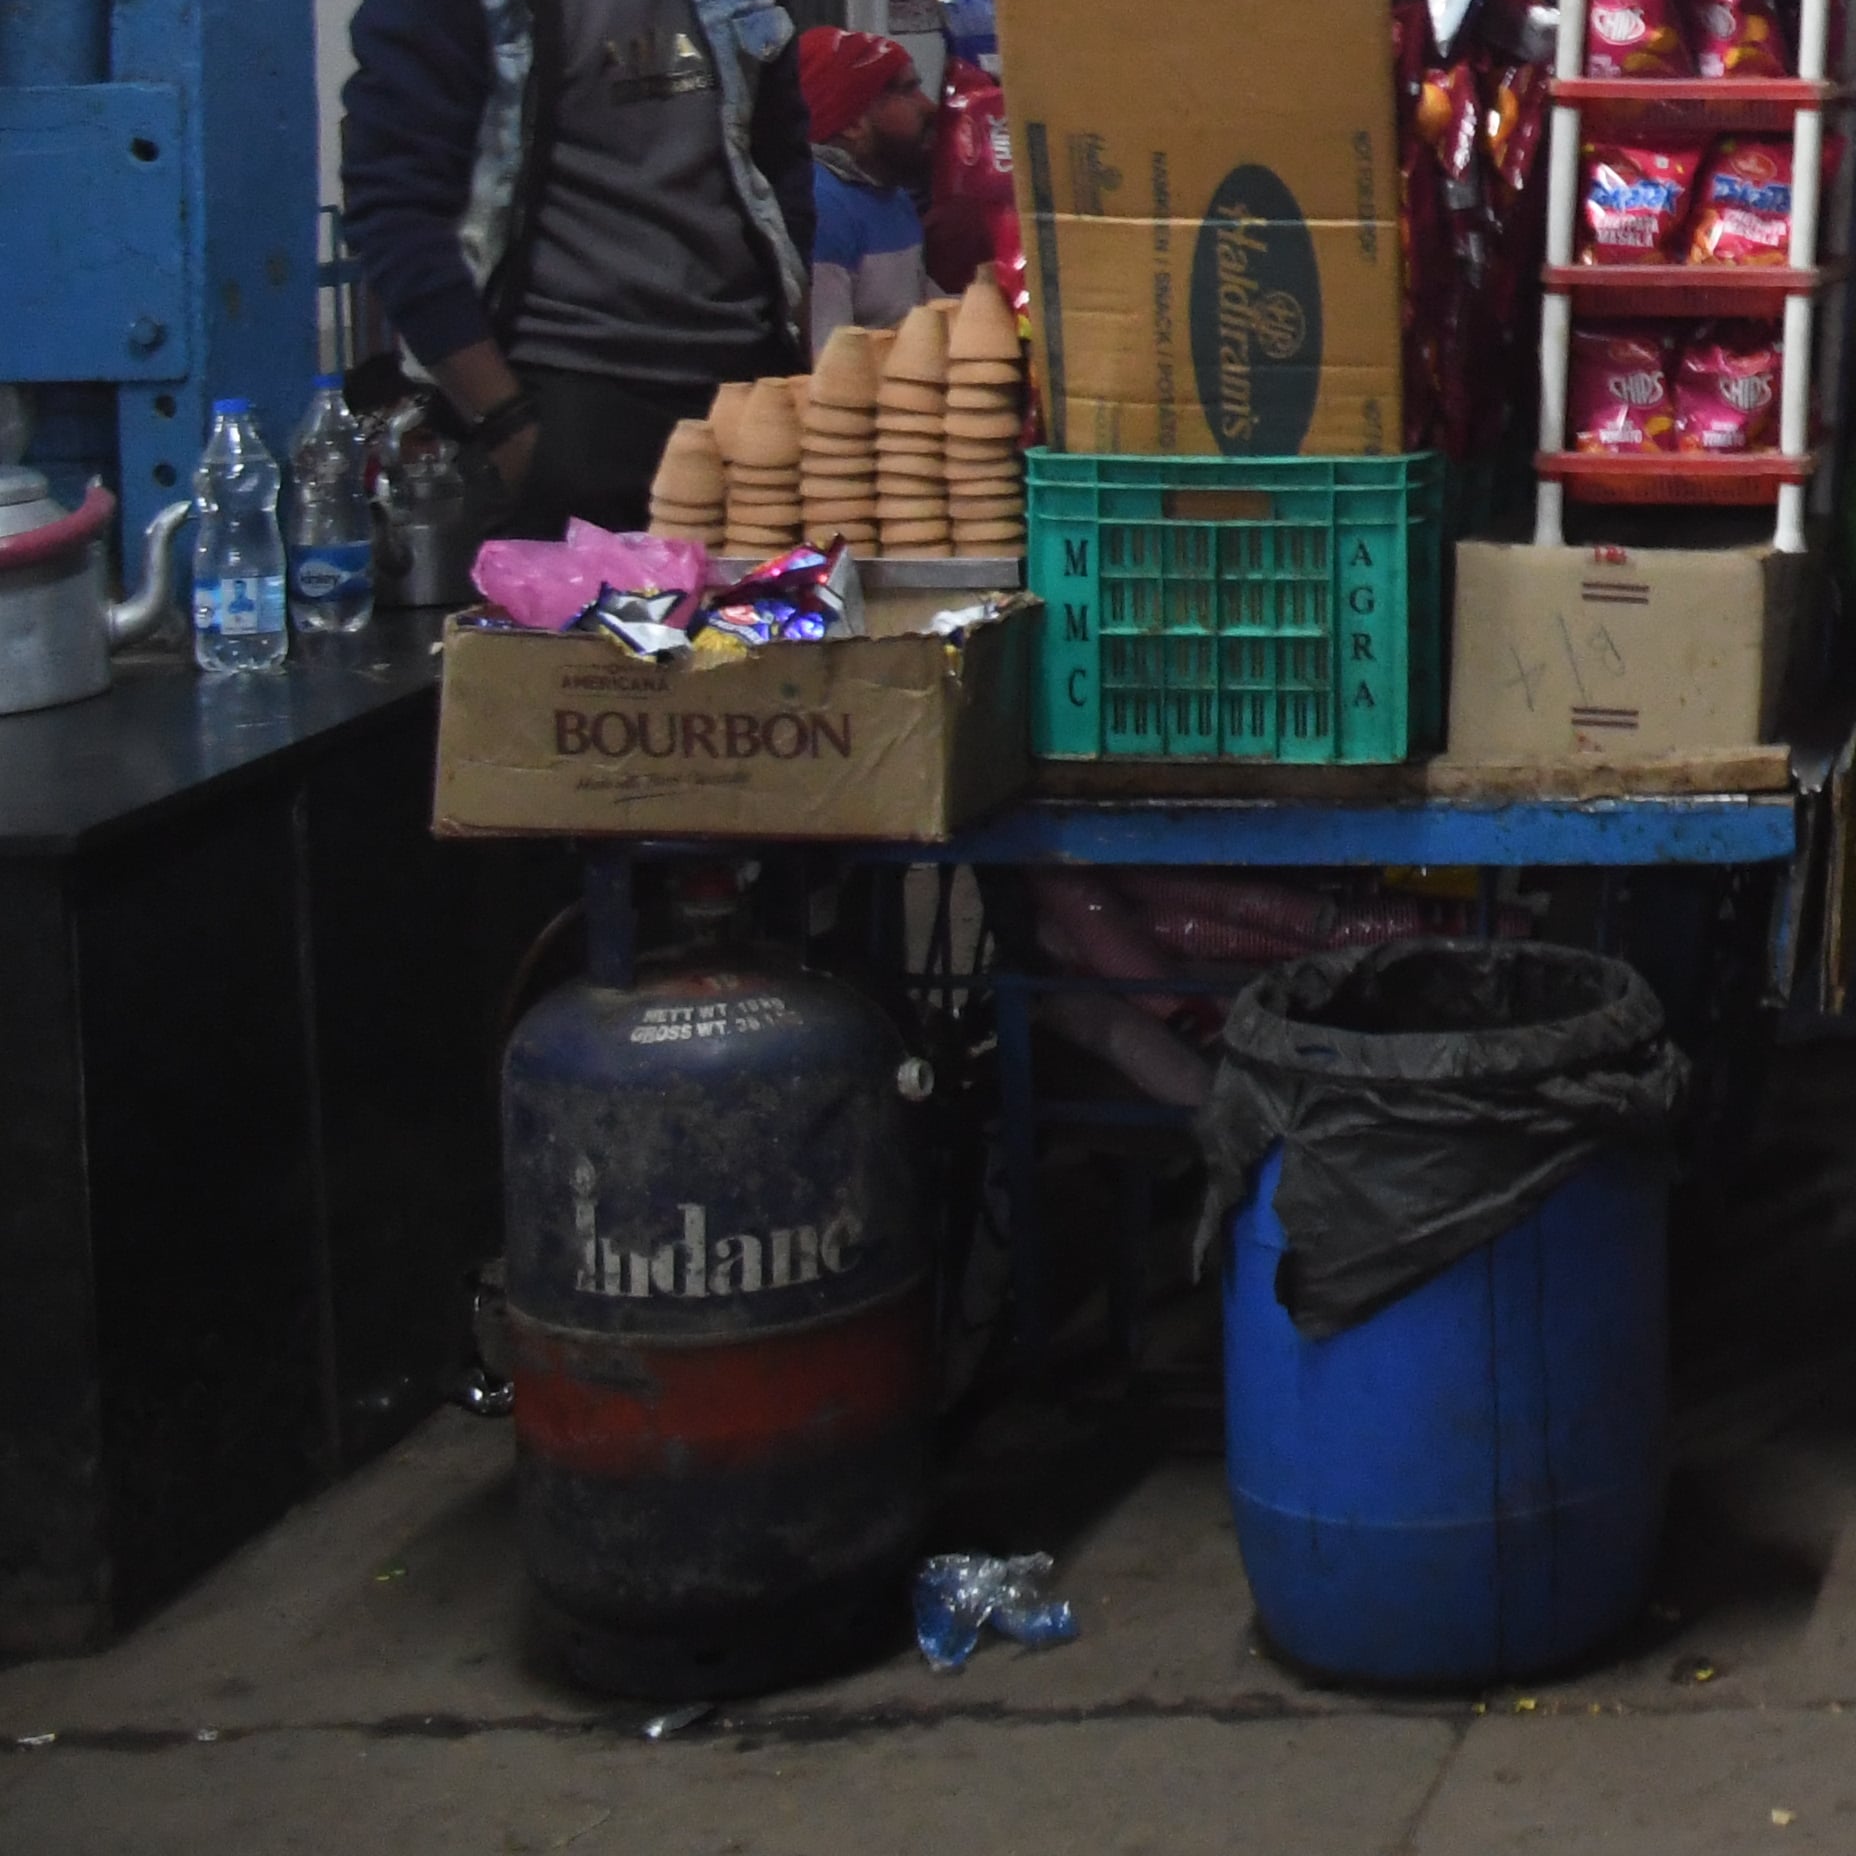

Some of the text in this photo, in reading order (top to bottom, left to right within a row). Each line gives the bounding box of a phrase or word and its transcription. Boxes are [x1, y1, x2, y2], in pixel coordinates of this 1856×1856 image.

[1609, 370, 1665, 408] CHIPS
[1718, 371, 1774, 412] CHIPS
[561, 674, 671, 693] AMERICANA
[555, 707, 853, 761] BOURBON
[630, 1023, 693, 1045] GROSS
